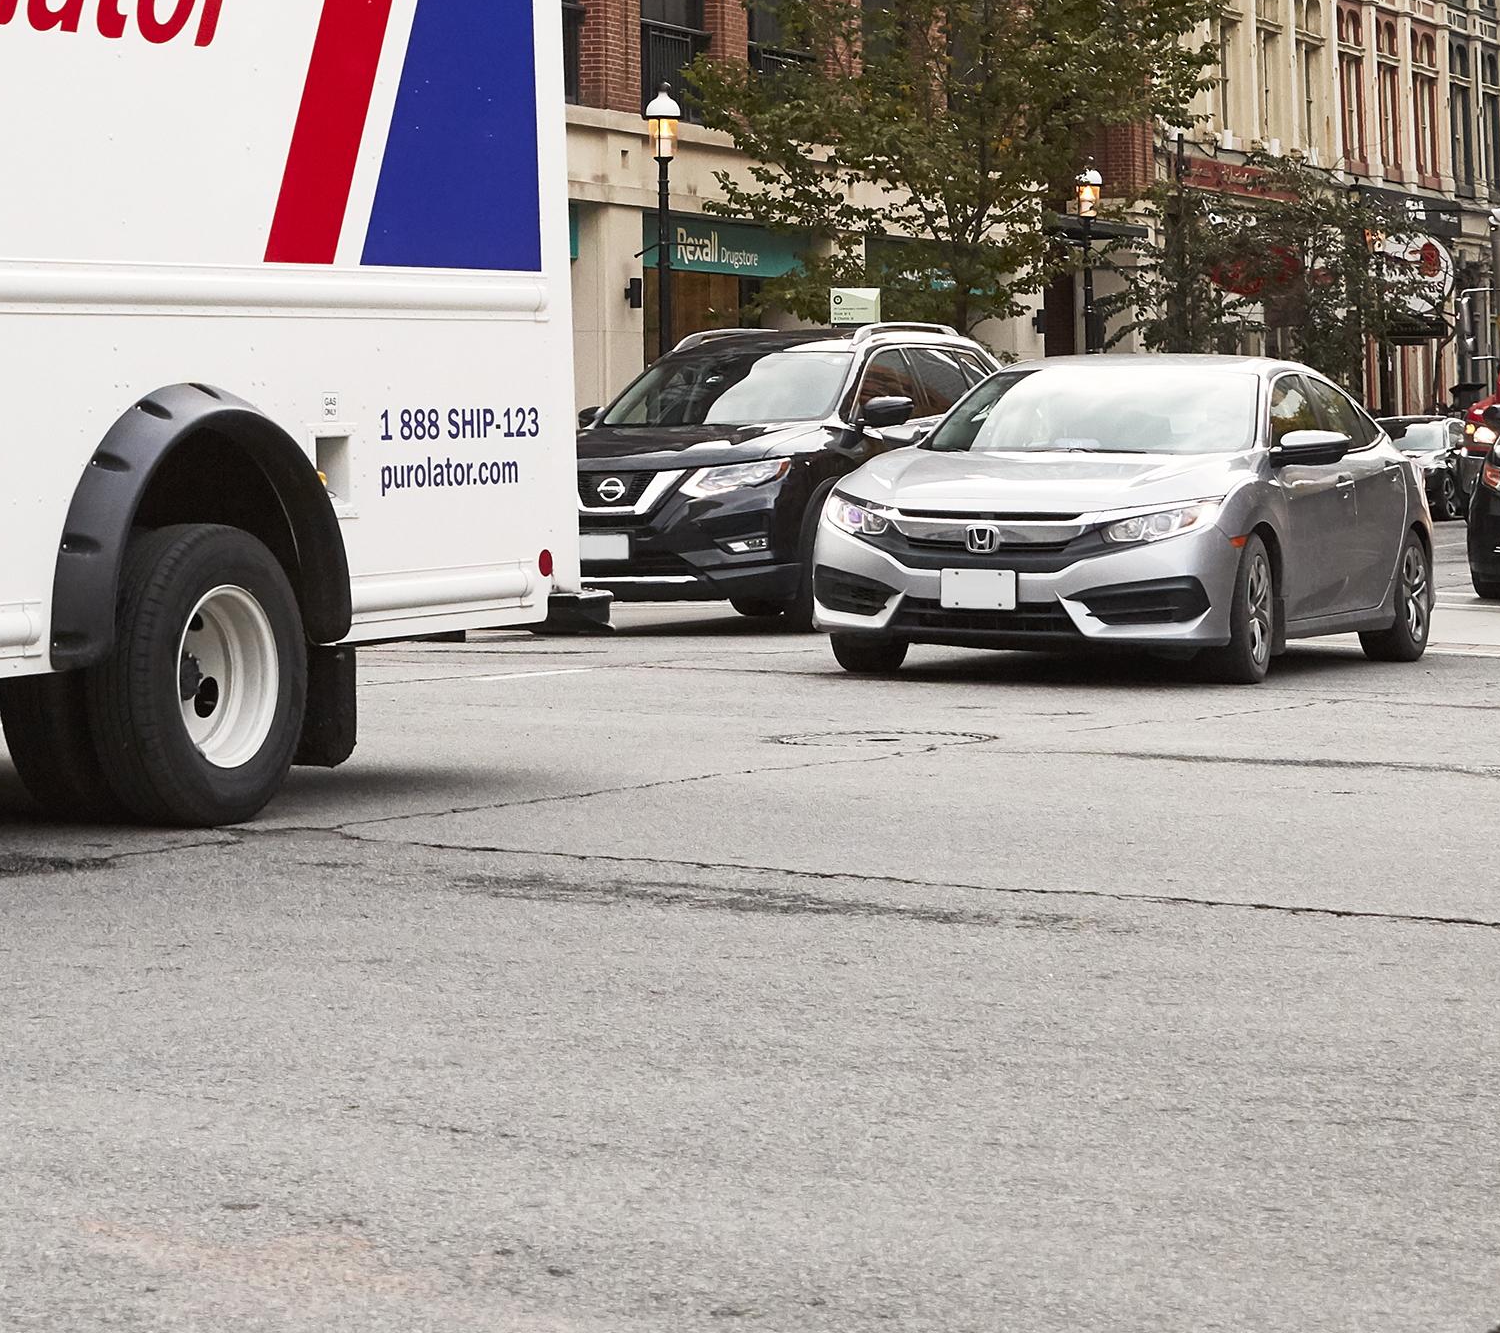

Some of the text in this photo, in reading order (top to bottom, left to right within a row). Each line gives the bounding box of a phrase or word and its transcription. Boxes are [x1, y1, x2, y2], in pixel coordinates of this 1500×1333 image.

[677, 227, 759, 268] Rexall Drugstore
[324, 397, 336, 406] GAS
[380, 407, 539, 441] 1 888 SHIP-123
[381, 456, 518, 496] purolator.com
